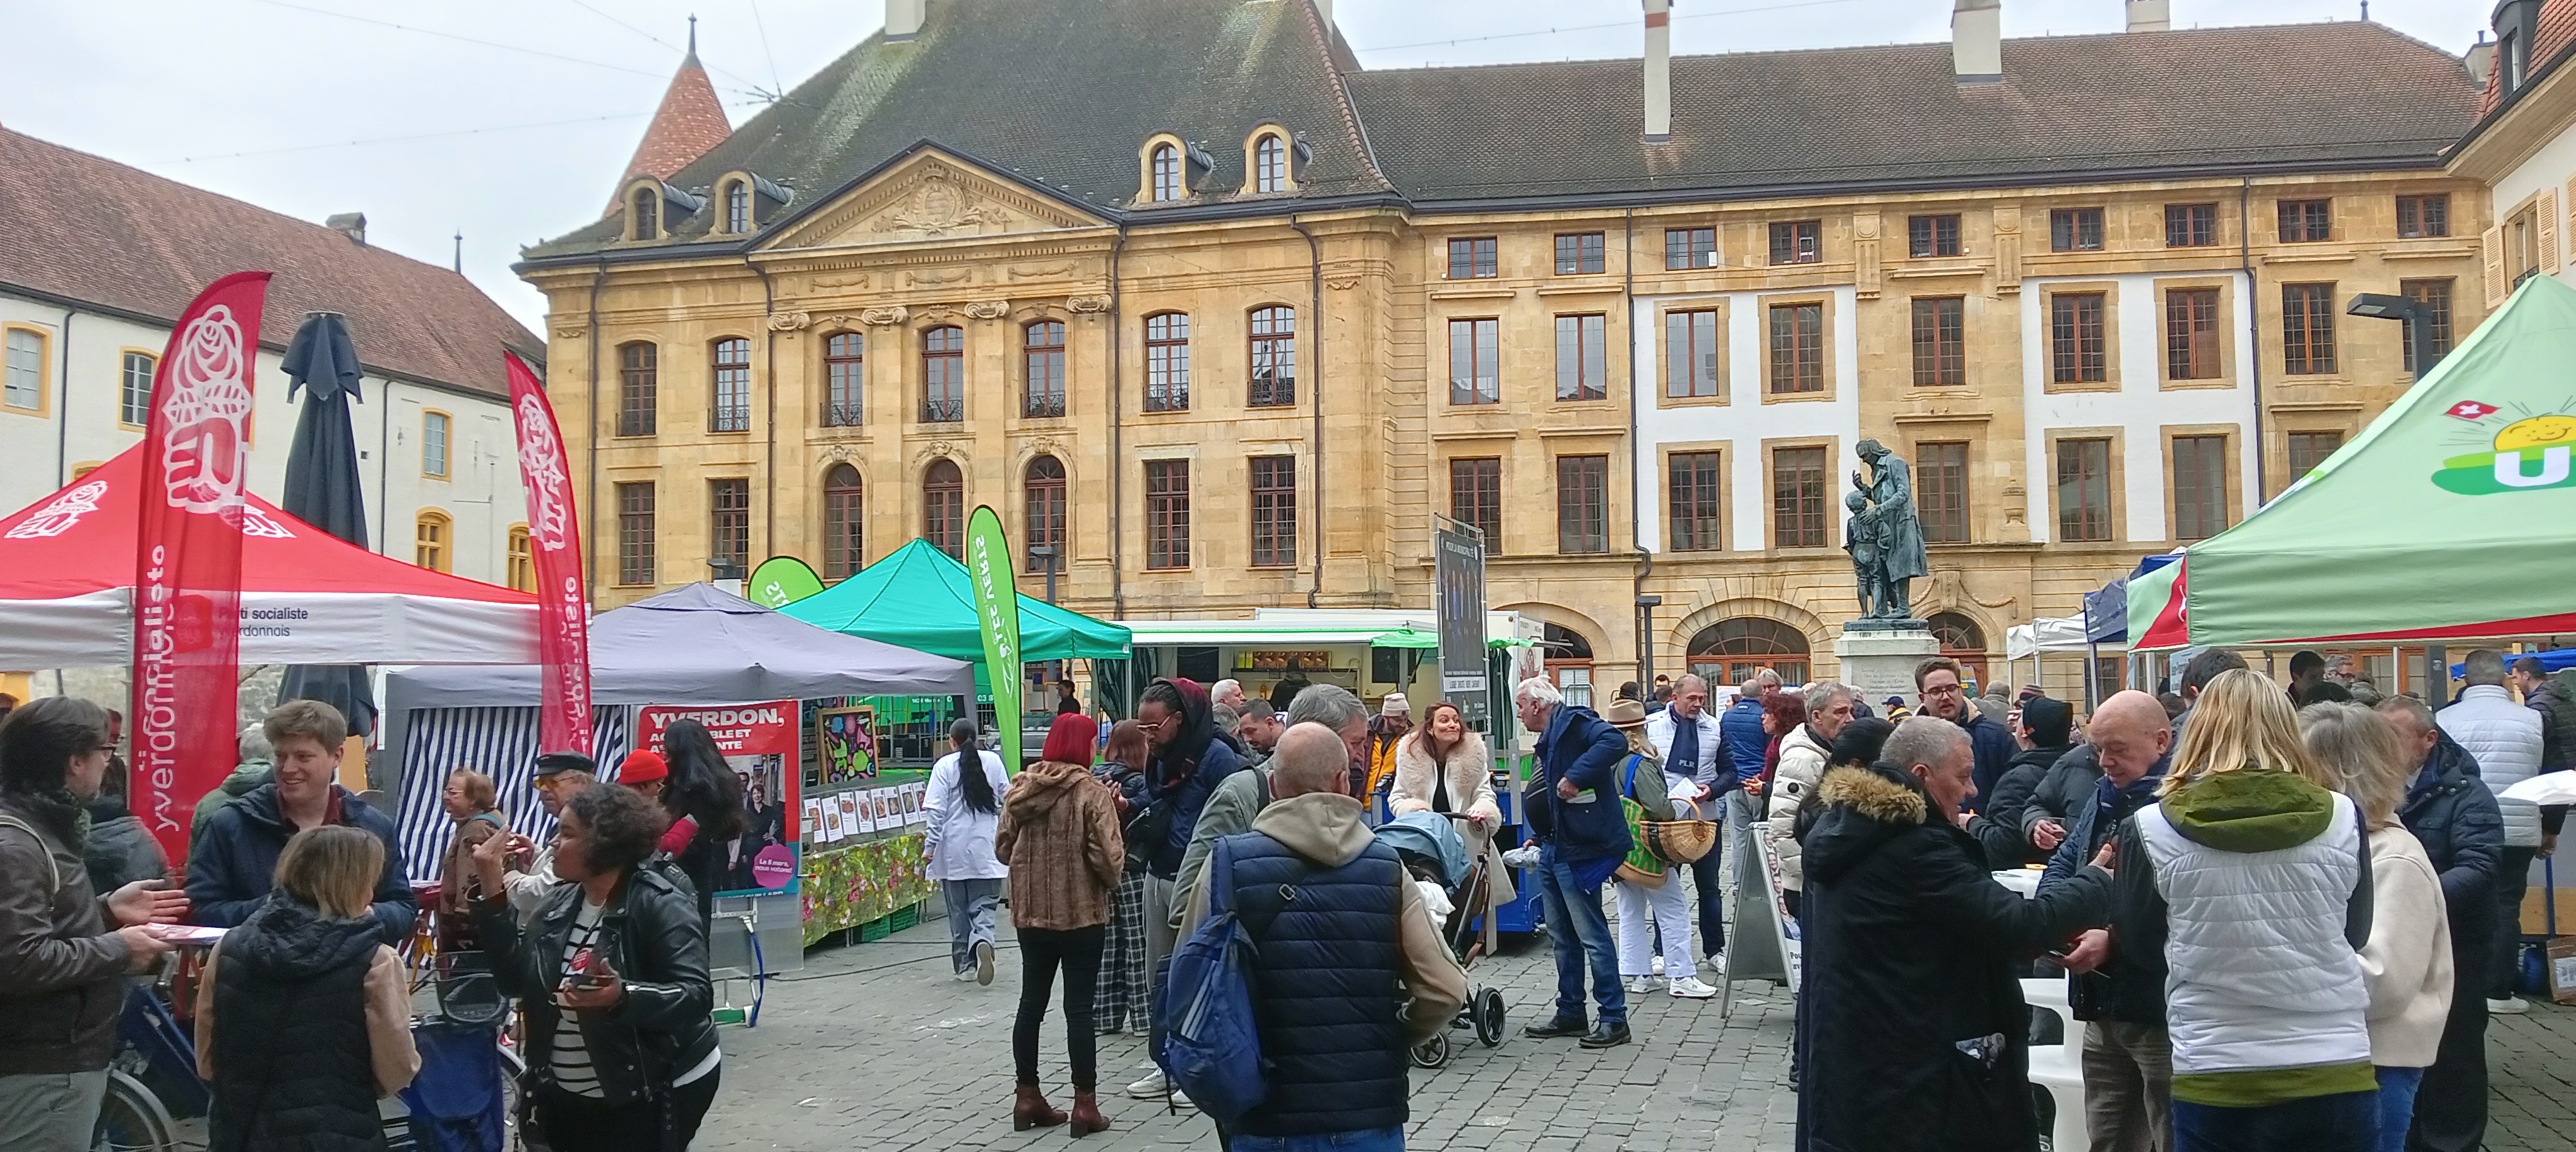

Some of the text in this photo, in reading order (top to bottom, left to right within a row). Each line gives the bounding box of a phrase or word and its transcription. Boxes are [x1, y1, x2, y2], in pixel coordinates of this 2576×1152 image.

[252, 607, 308, 620] socialiste
[735, 729, 751, 738] ET
[1679, 759, 1695, 768] PLR
[1789, 951, 1802, 959] Pou
